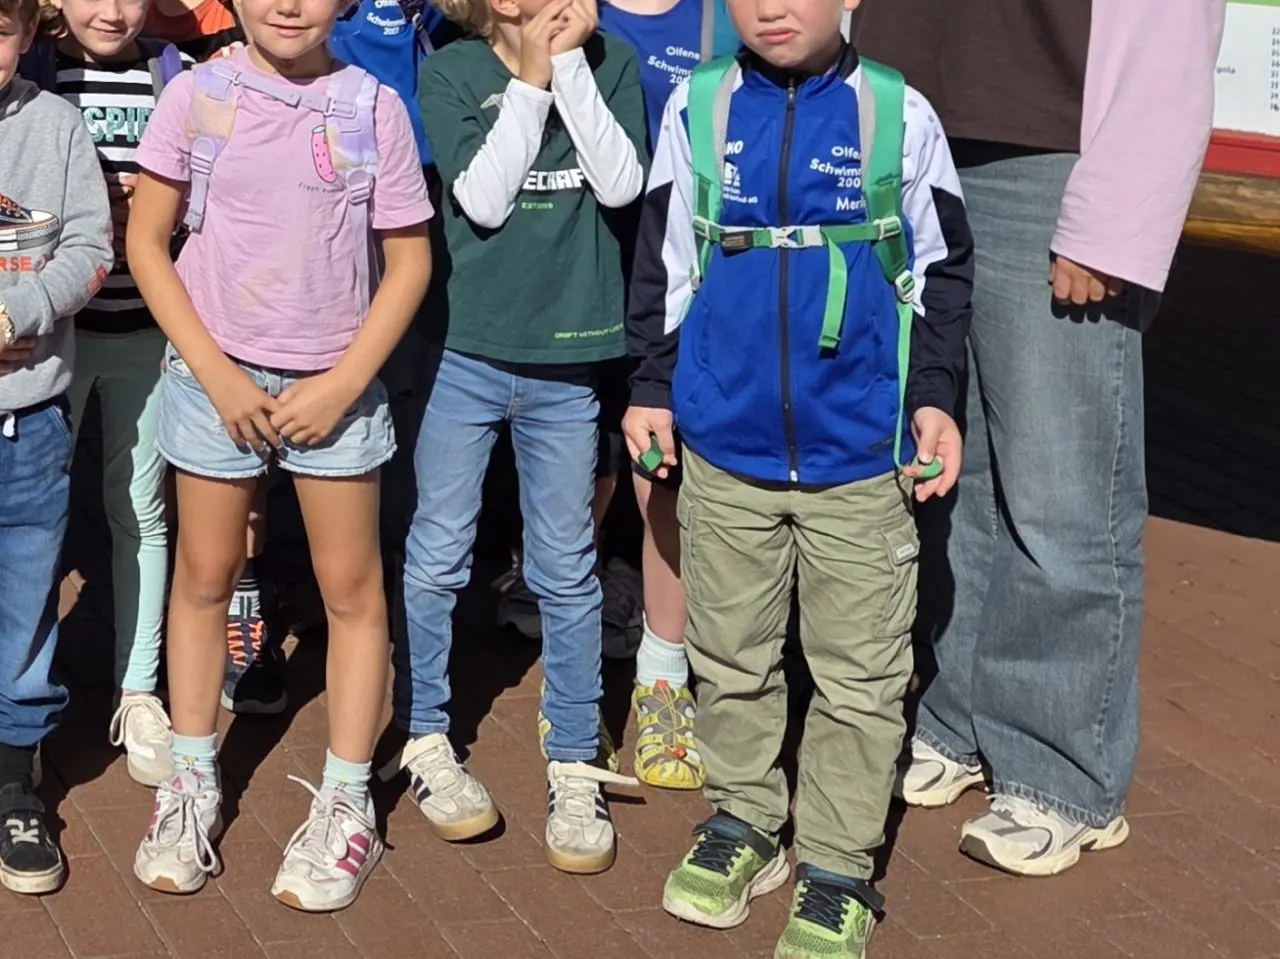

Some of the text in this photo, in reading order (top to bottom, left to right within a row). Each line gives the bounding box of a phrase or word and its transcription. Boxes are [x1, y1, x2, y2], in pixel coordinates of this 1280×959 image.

[665, 45, 700, 60] Olfene
[725, 140, 744, 155] KO
[831, 146, 861, 160] Olfe
[522, 168, 585, 191] ECRAF
[836, 177, 861, 189] 200
